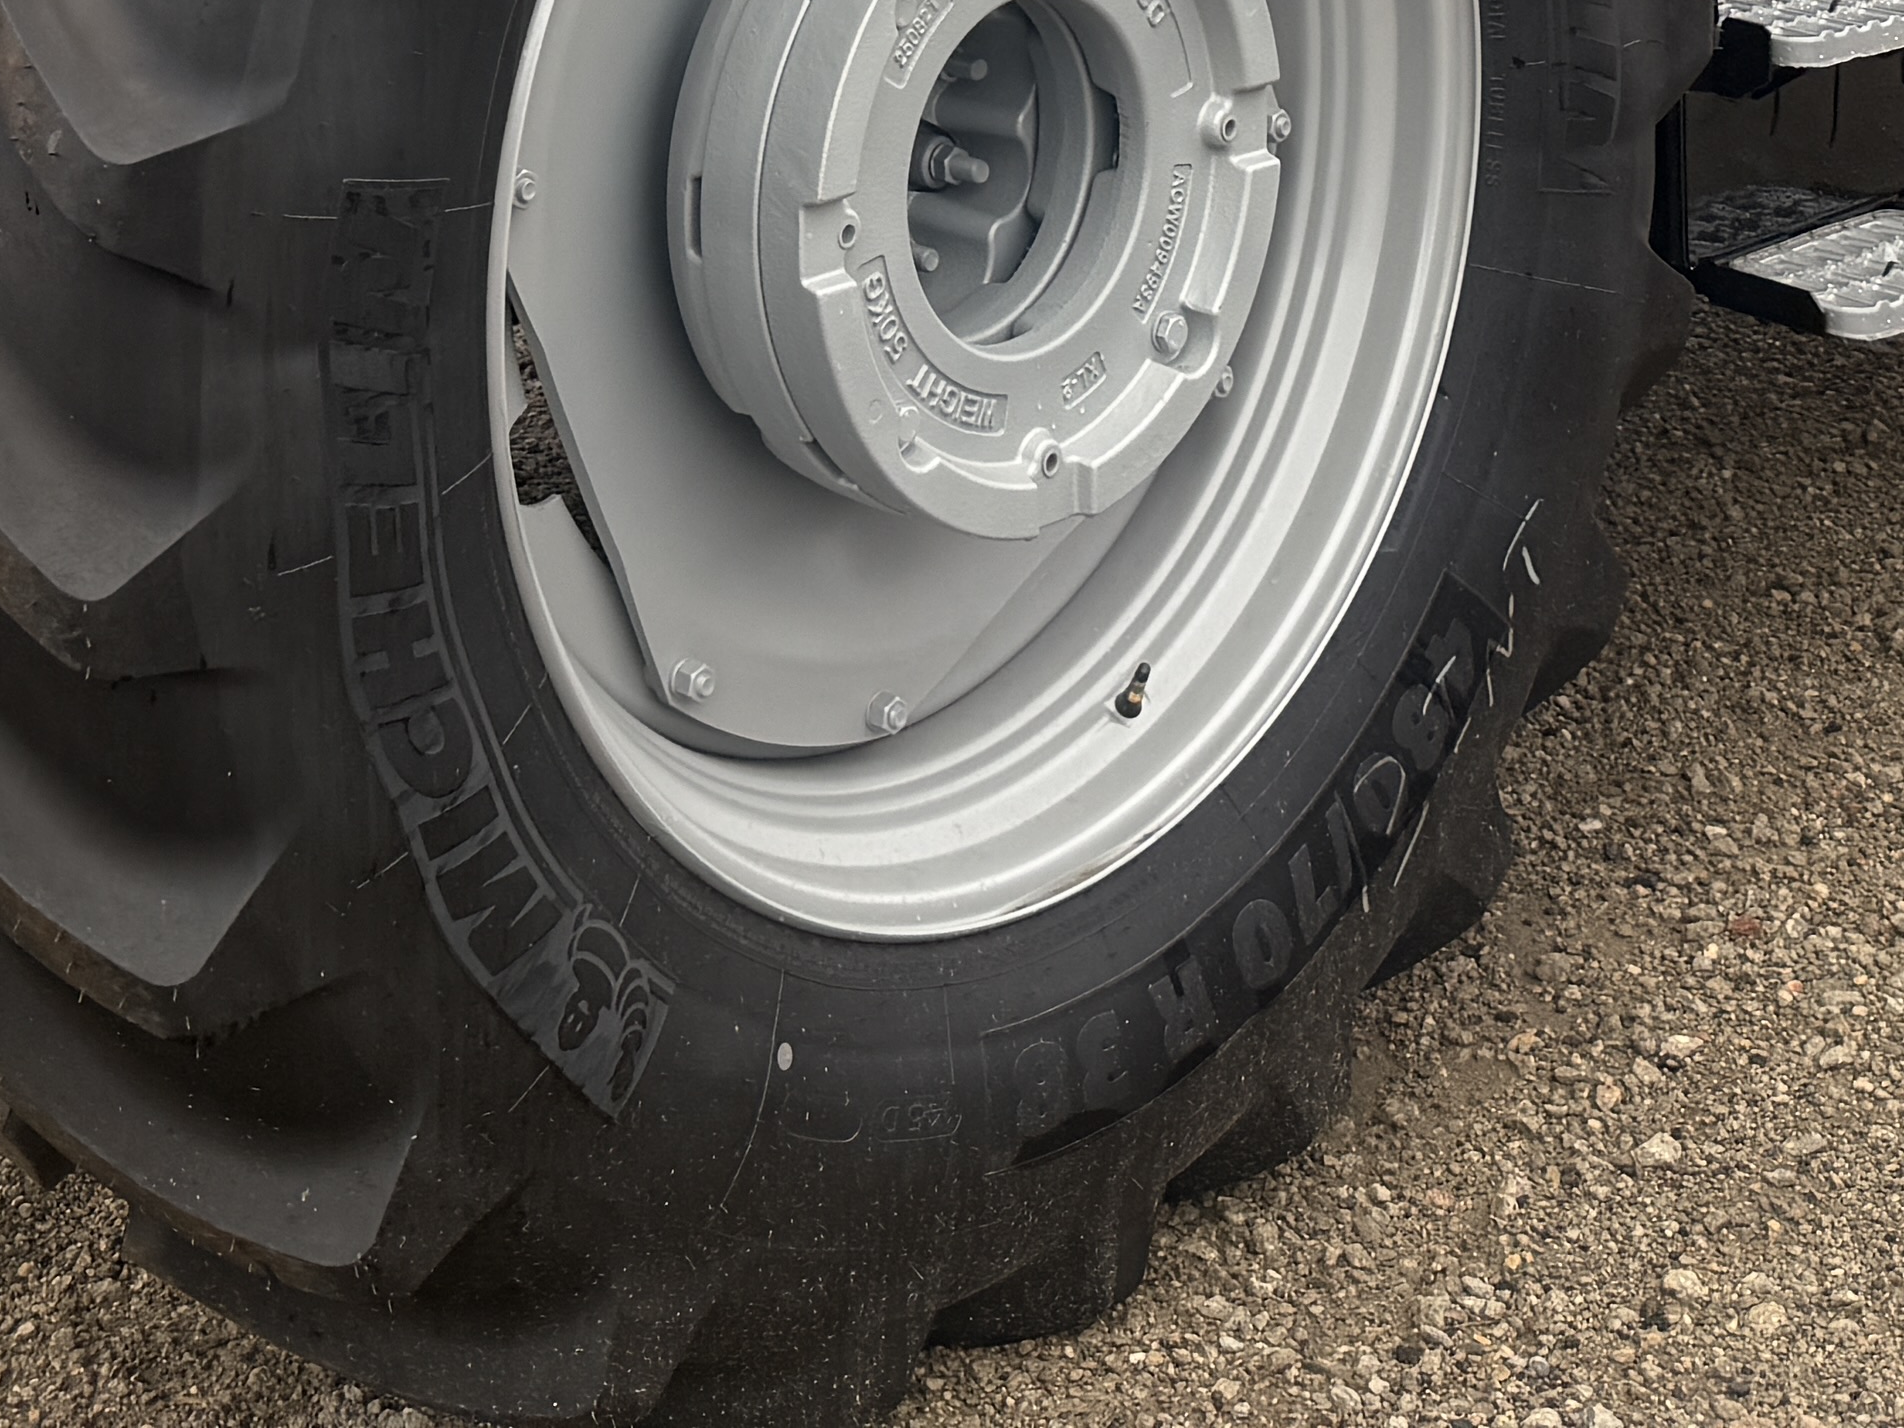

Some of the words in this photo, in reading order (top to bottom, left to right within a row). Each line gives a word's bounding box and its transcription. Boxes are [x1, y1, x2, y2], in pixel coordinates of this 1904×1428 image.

[863, 271, 908, 364] 50KG
[906, 363, 998, 431] WEIGHT
[337, 179, 562, 974] MICHELIN
[1227, 620, 1500, 999] 480/70
[1148, 952, 1224, 1069] R
[1003, 1006, 1137, 1146] 38
